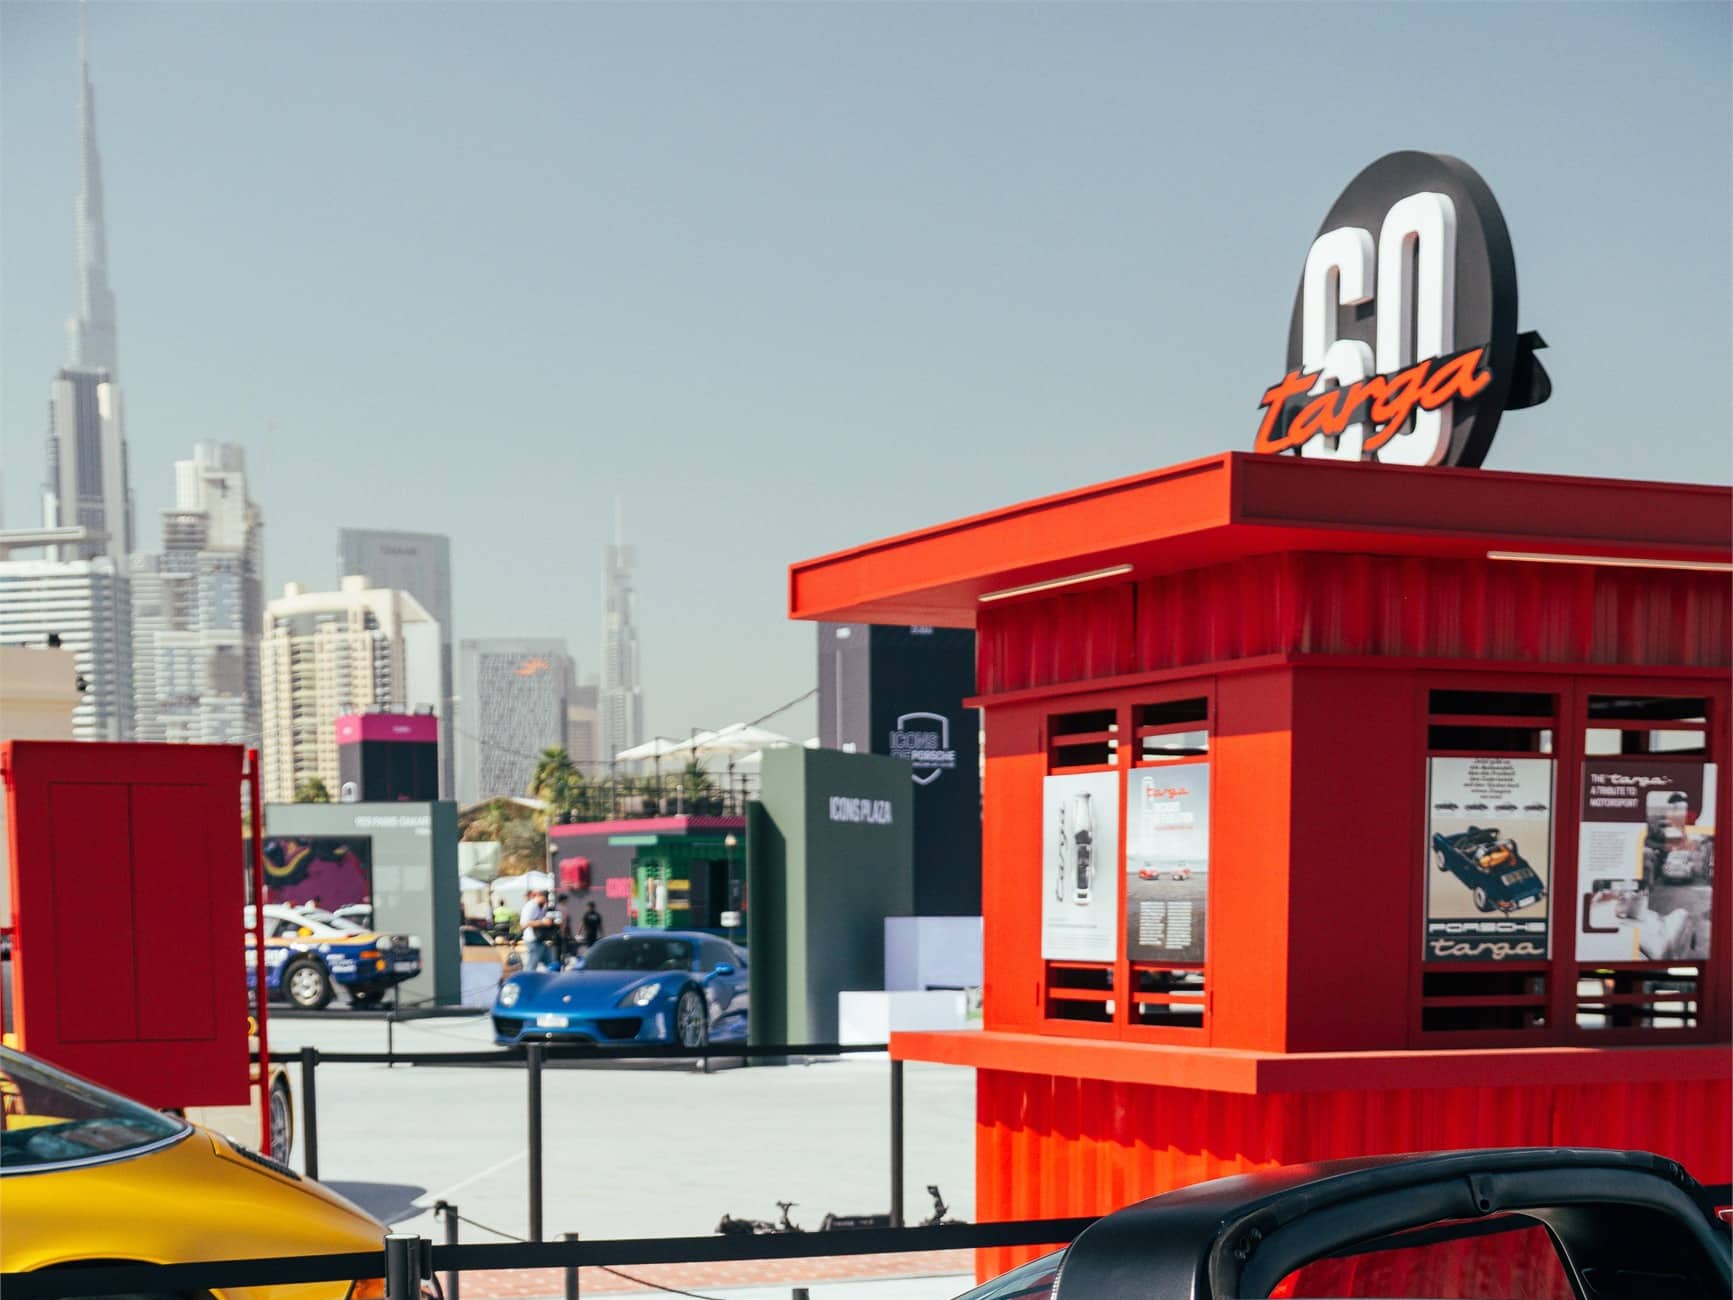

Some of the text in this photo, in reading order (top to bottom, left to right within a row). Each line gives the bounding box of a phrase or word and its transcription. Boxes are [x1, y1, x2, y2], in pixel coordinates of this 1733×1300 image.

[1303, 193, 1457, 465] 60
[1254, 347, 1492, 454] targa
[889, 731, 938, 749] ICONS
[829, 796, 893, 824] ICONS PLAZA
[1429, 922, 1546, 933] PORSCHE
[1430, 938, 1545, 960] targa
